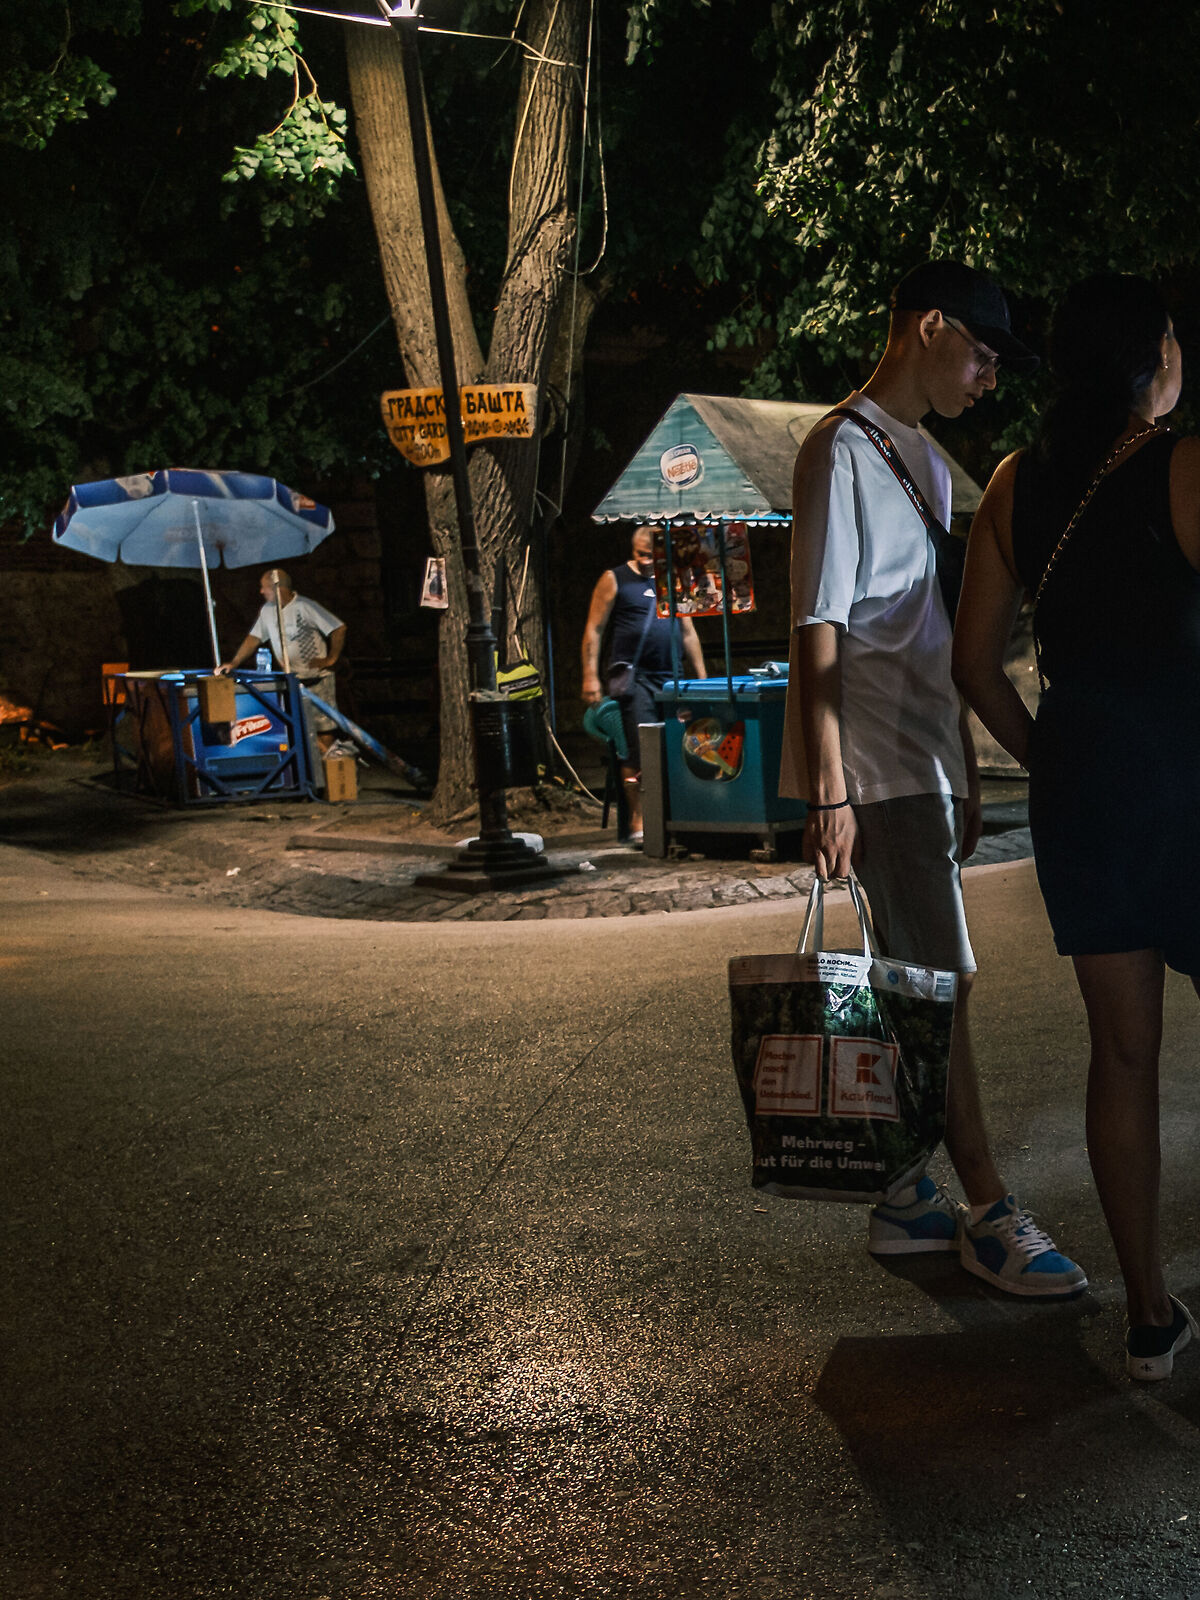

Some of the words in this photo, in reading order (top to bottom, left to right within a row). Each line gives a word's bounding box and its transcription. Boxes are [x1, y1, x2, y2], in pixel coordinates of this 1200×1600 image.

[387, 394, 446, 420] ГРАДСК
[465, 391, 525, 415] БАШТА
[419, 422, 446, 439] GARD
[781, 1134, 854, 1153] Mehrweg
[781, 1154, 804, 1168] für
[809, 1155, 834, 1169] die
[837, 1156, 886, 1172] Umwel
